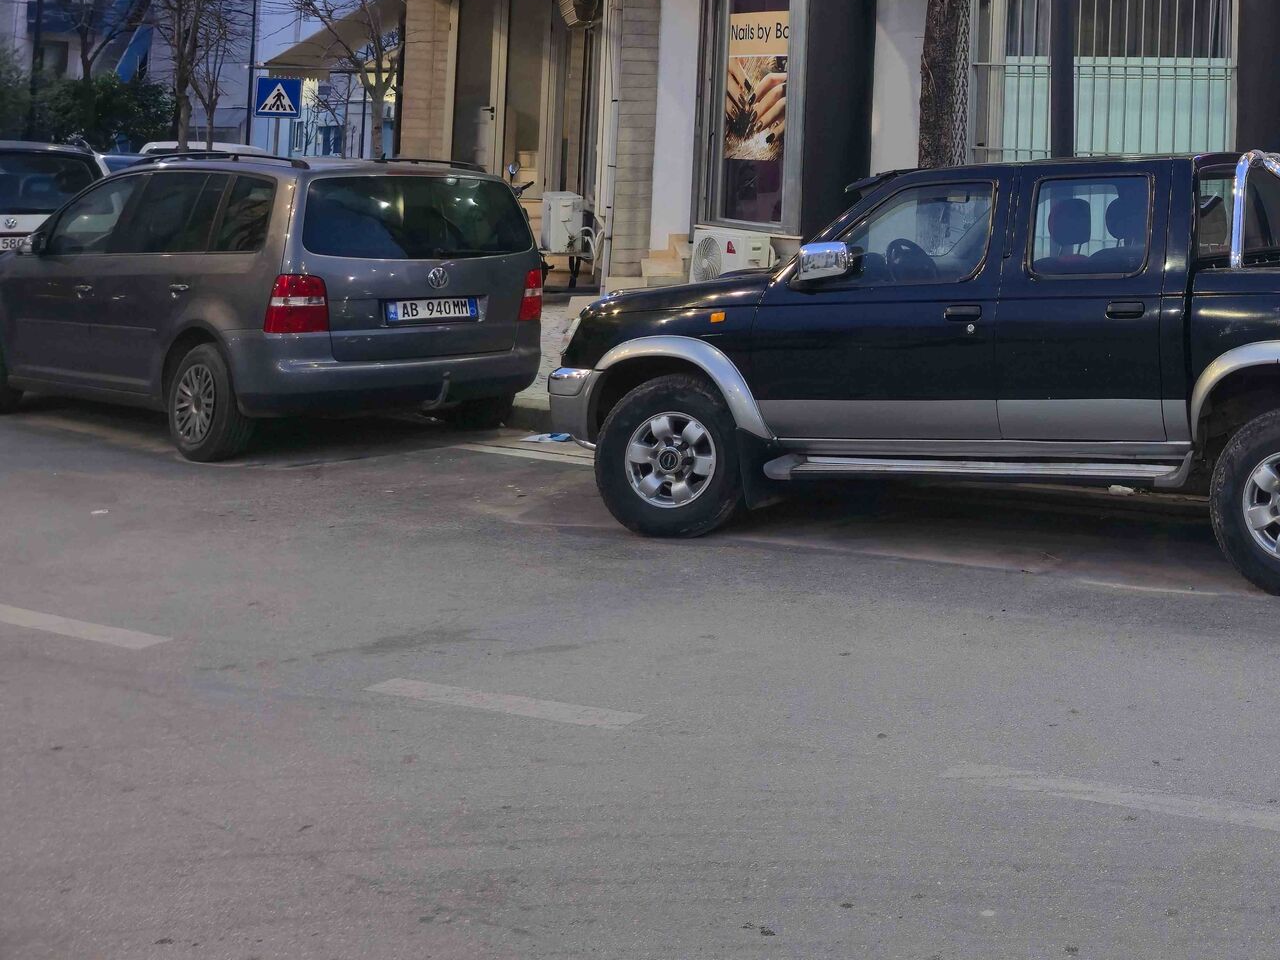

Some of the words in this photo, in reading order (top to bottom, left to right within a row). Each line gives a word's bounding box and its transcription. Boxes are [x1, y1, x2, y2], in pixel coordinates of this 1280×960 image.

[731, 24, 755, 41] Nails
[757, 23, 772, 43] by
[402, 303, 419, 318] AB
